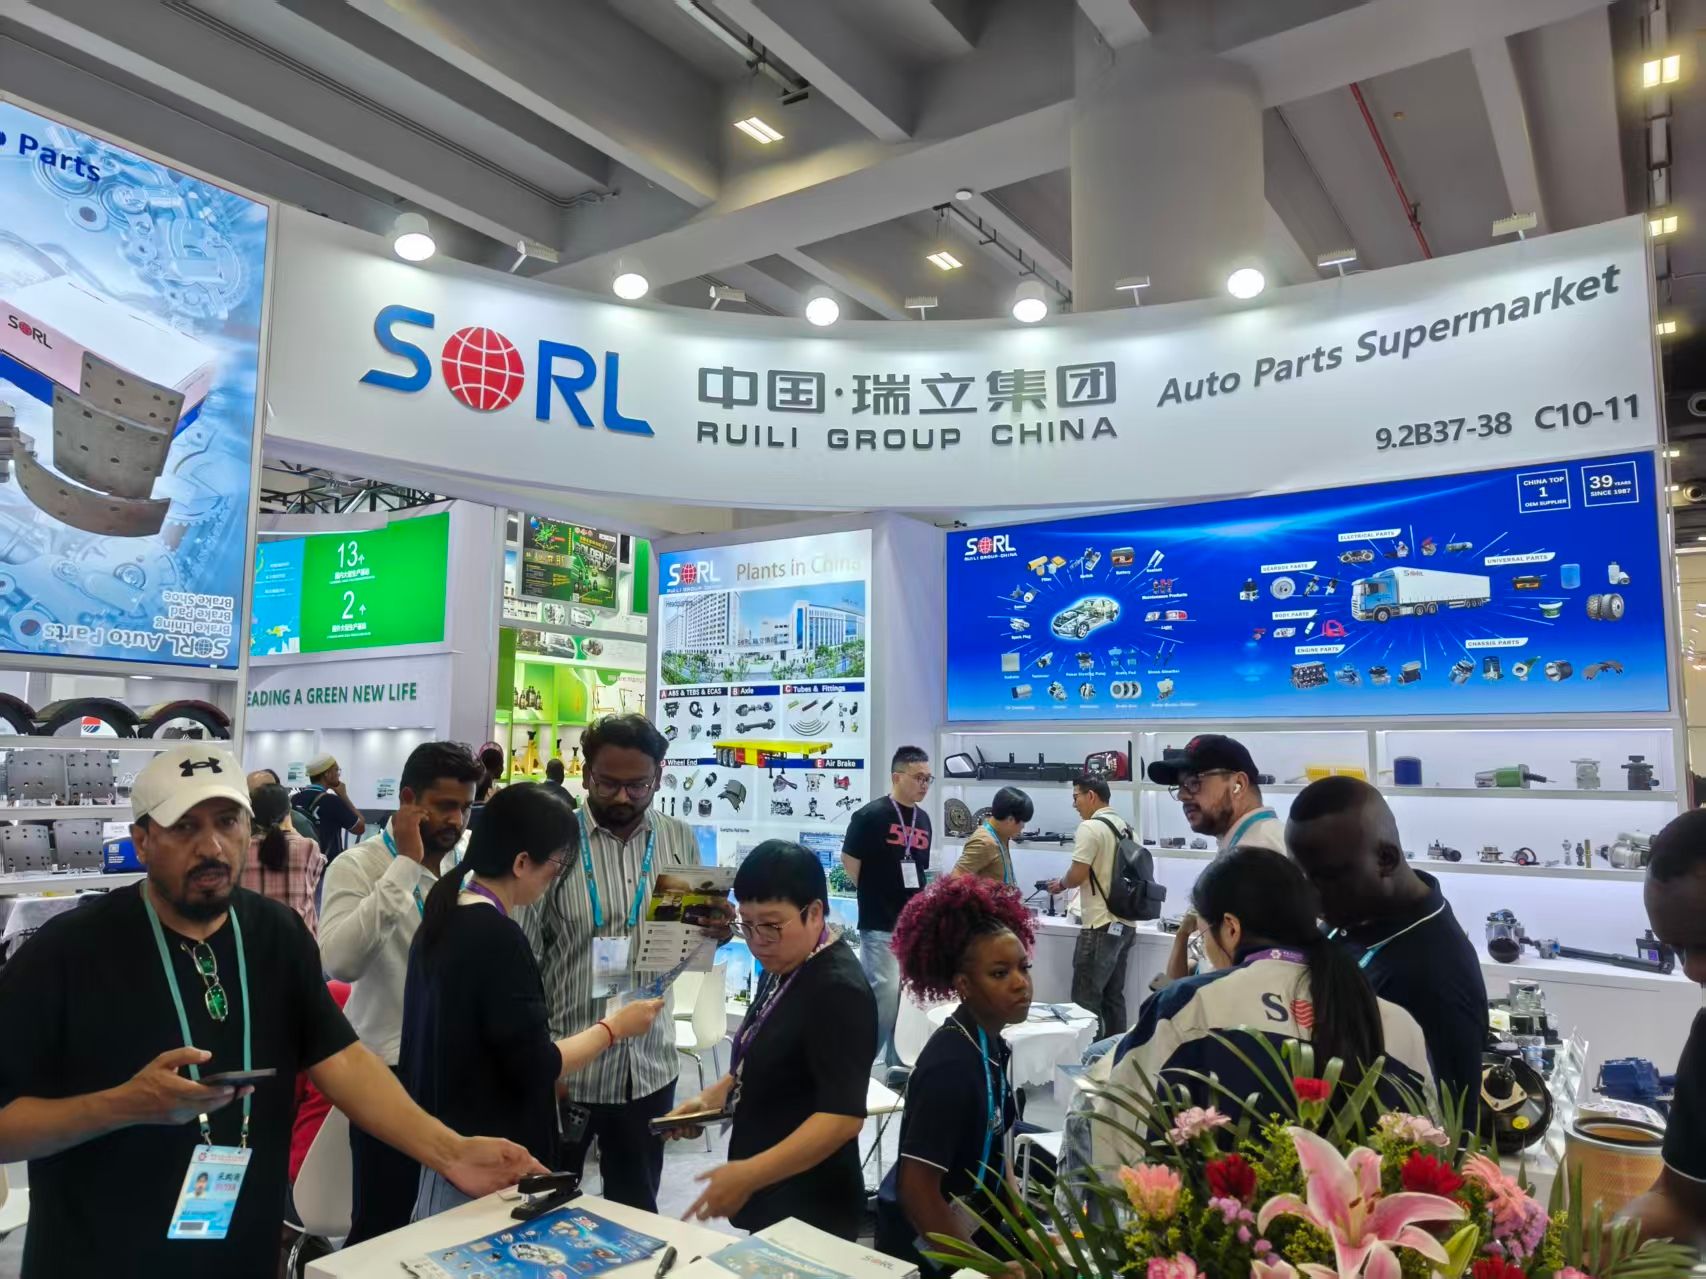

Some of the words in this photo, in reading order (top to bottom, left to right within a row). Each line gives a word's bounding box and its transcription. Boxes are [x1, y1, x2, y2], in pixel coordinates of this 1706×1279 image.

[19, 133, 101, 183] Parts
[8, 314, 53, 350] SORL
[1156, 371, 1241, 407] Auto
[1253, 343, 1343, 387] Parts
[1355, 264, 1621, 363] Supermarket
[359, 304, 656, 437] SORL
[1375, 411, 1513, 450] 9.2B37-38
[1534, 393, 1640, 430] C10-11
[697, 420, 797, 449] RUILI
[827, 427, 961, 450] GROUP
[991, 416, 1118, 447] CHINA
[1523, 478, 1547, 486] CHINA
[1589, 475, 1613, 489] 39
[1539, 486, 1548, 497] 1
[965, 534, 1017, 556] SORL
[666, 560, 721, 586] SORL
[736, 561, 786, 581] Plants
[791, 558, 805, 575] in
[162, 590, 196, 605] Shoe
[197, 594, 233, 609] Brake
[168, 605, 195, 620] Pad
[195, 608, 232, 622] Brake
[153, 616, 194, 634] Lining
[194, 621, 232, 636] Brake
[43, 623, 105, 647] Parts
[108, 629, 163, 652] Auto
[166, 633, 231, 659] SORL
[293, 688, 303, 705] A
[306, 686, 348, 704] GREEN
[352, 683, 385, 703] NEW
[388, 682, 417, 701] LIFE
[668, 689, 679, 697] ABS
[740, 687, 754, 695] Axle
[821, 684, 846, 693] Fittings
[825, 759, 836, 767] Air
